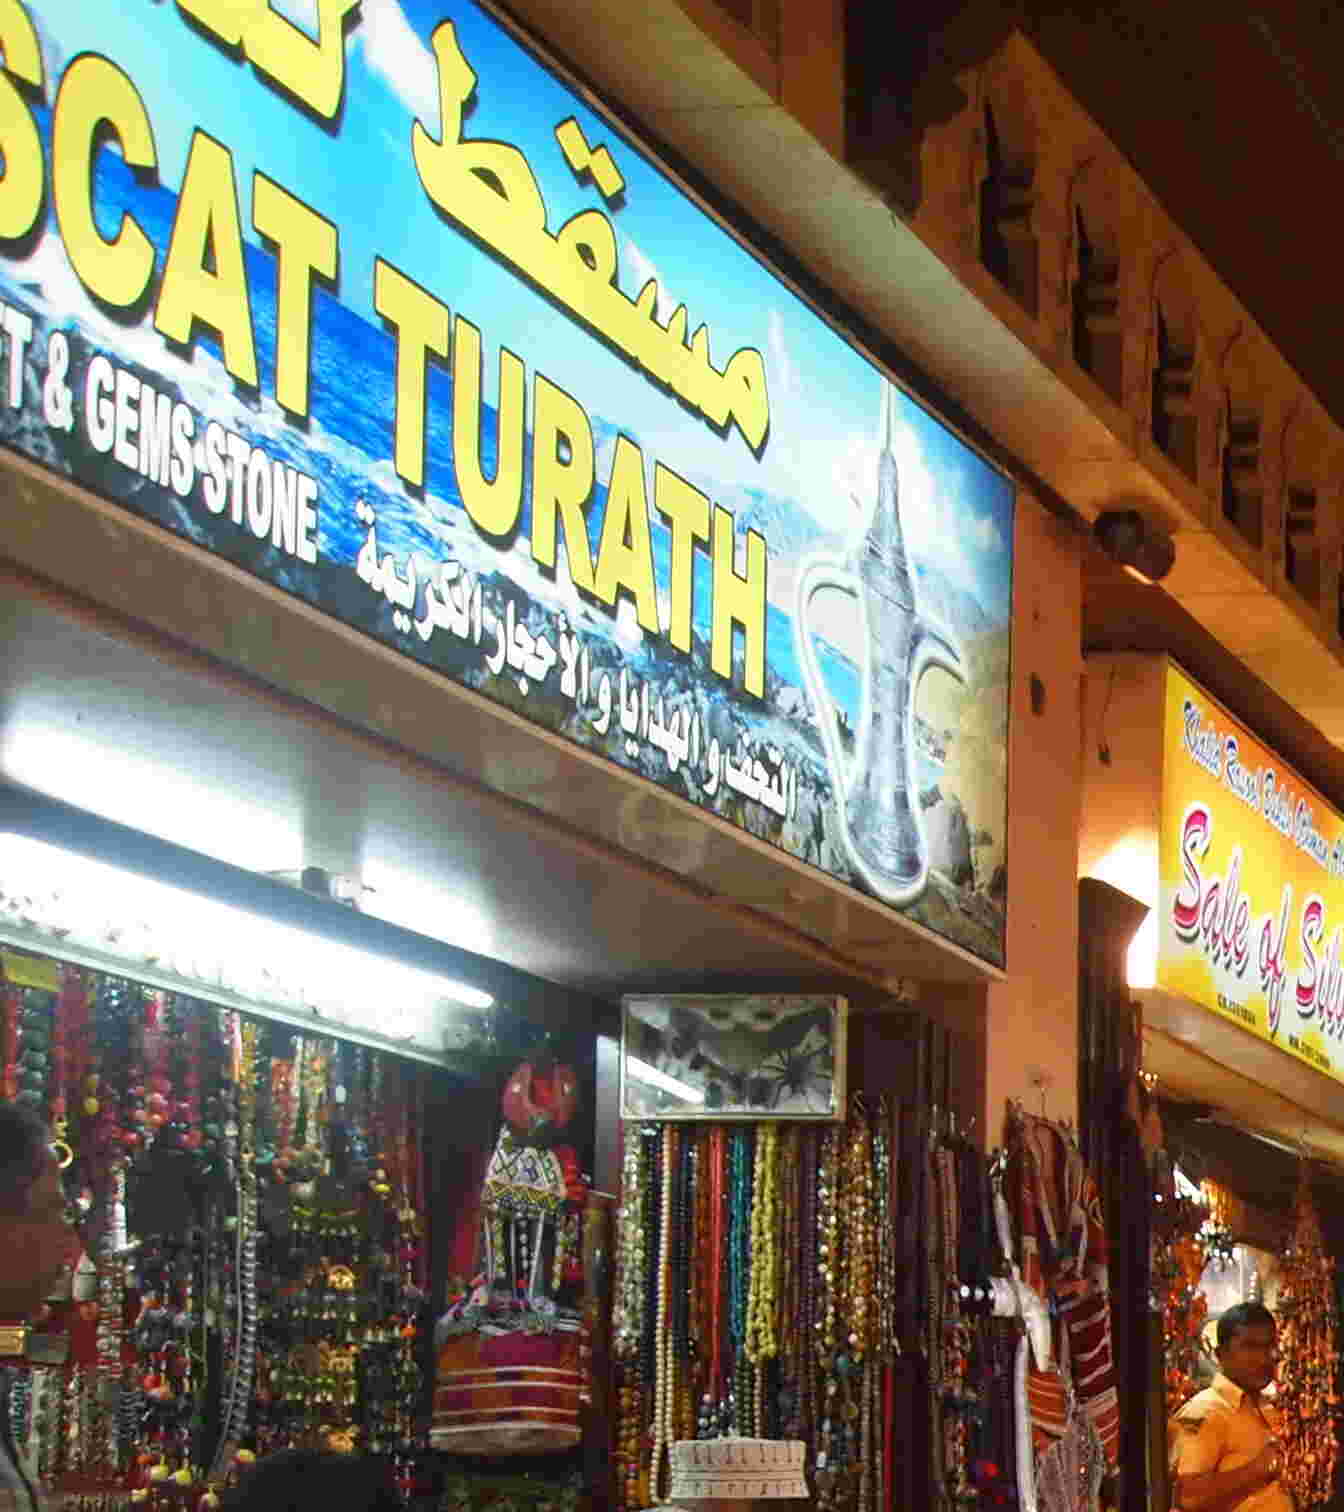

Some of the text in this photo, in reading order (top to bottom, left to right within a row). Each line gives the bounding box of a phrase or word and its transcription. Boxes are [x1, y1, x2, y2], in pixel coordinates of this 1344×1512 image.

[43, 331, 73, 432] &
[411, 20, 771, 450] مسقط
[374, 256, 767, 698] TURATH
[1172, 806, 1250, 974] Sale
[1259, 884, 1292, 1036] of
